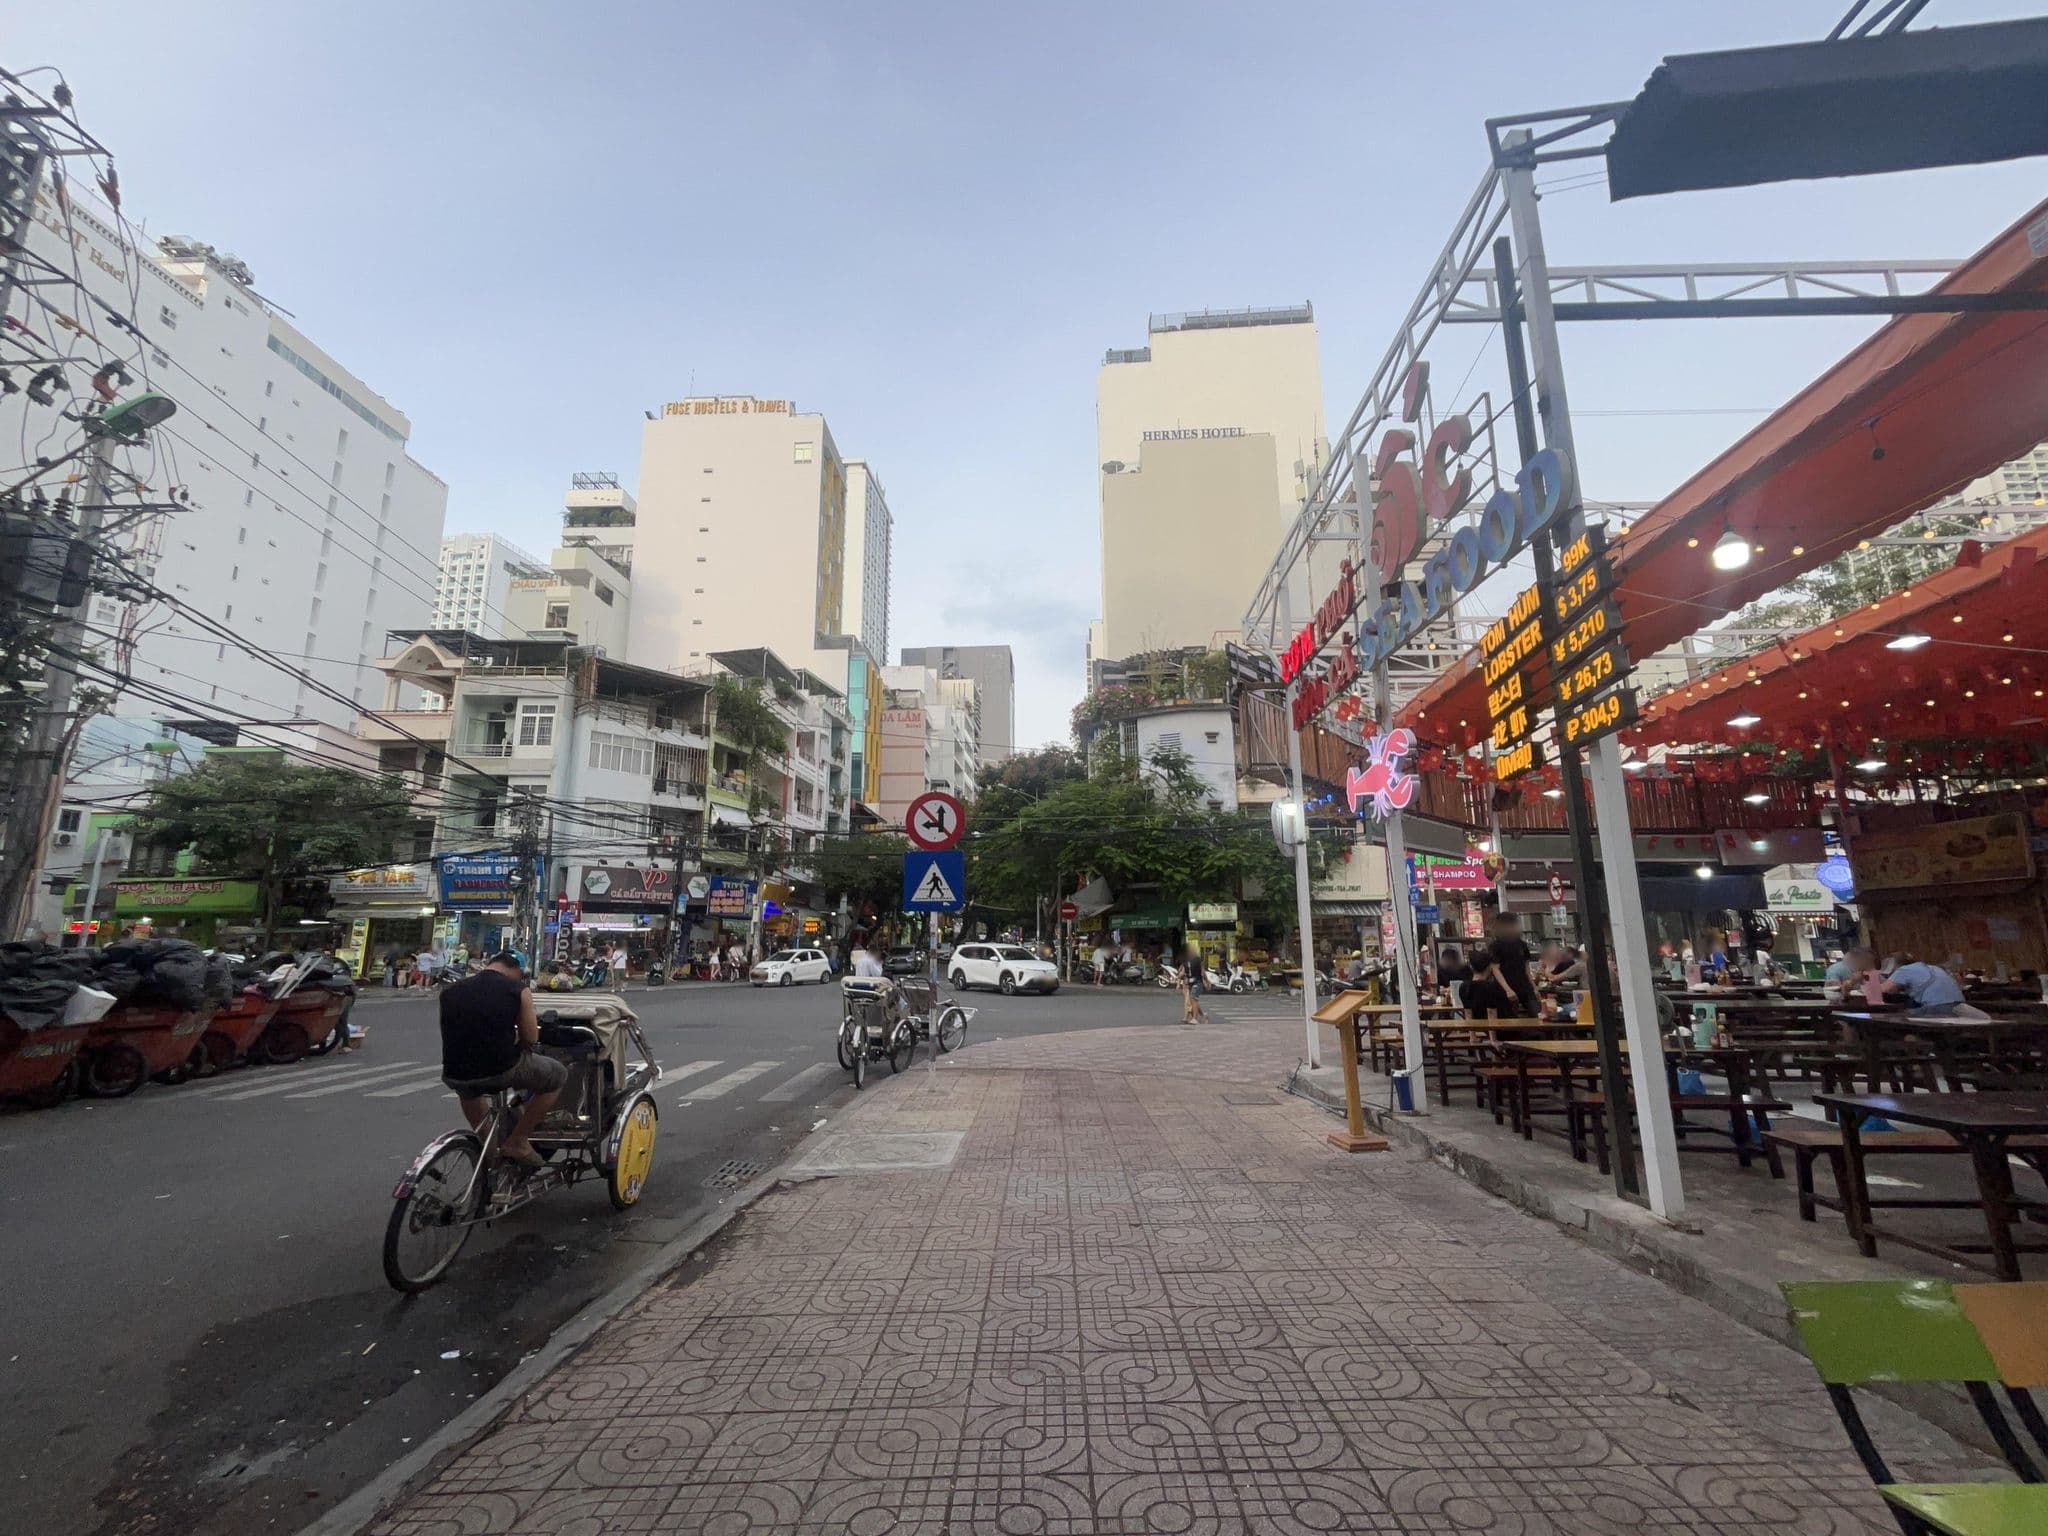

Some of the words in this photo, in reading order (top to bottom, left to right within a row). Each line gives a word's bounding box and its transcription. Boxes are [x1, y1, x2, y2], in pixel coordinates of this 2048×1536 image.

[90, 247, 125, 284] Hotel
[666, 401, 690, 415] FUSE
[694, 401, 737, 415] HOSTELS
[742, 401, 749, 413] &
[753, 400, 788, 413] TRAVEL
[1143, 430, 1198, 441] HERMES
[1201, 427, 1245, 439] HOTEL
[1360, 448, 1568, 671] SEAFOOD
[1563, 532, 1590, 572] 99K
[1558, 595, 1567, 618] $
[1568, 567, 1596, 607] 3,75
[1569, 609, 1605, 652] 5,210
[1484, 619, 1543, 687] LOBSTER
[1575, 652, 1612, 693] 26,73
[1488, 671, 1522, 718] 랍스터
[1582, 696, 1619, 733] 304,9
[1433, 870, 1476, 878] SHAMPOO
